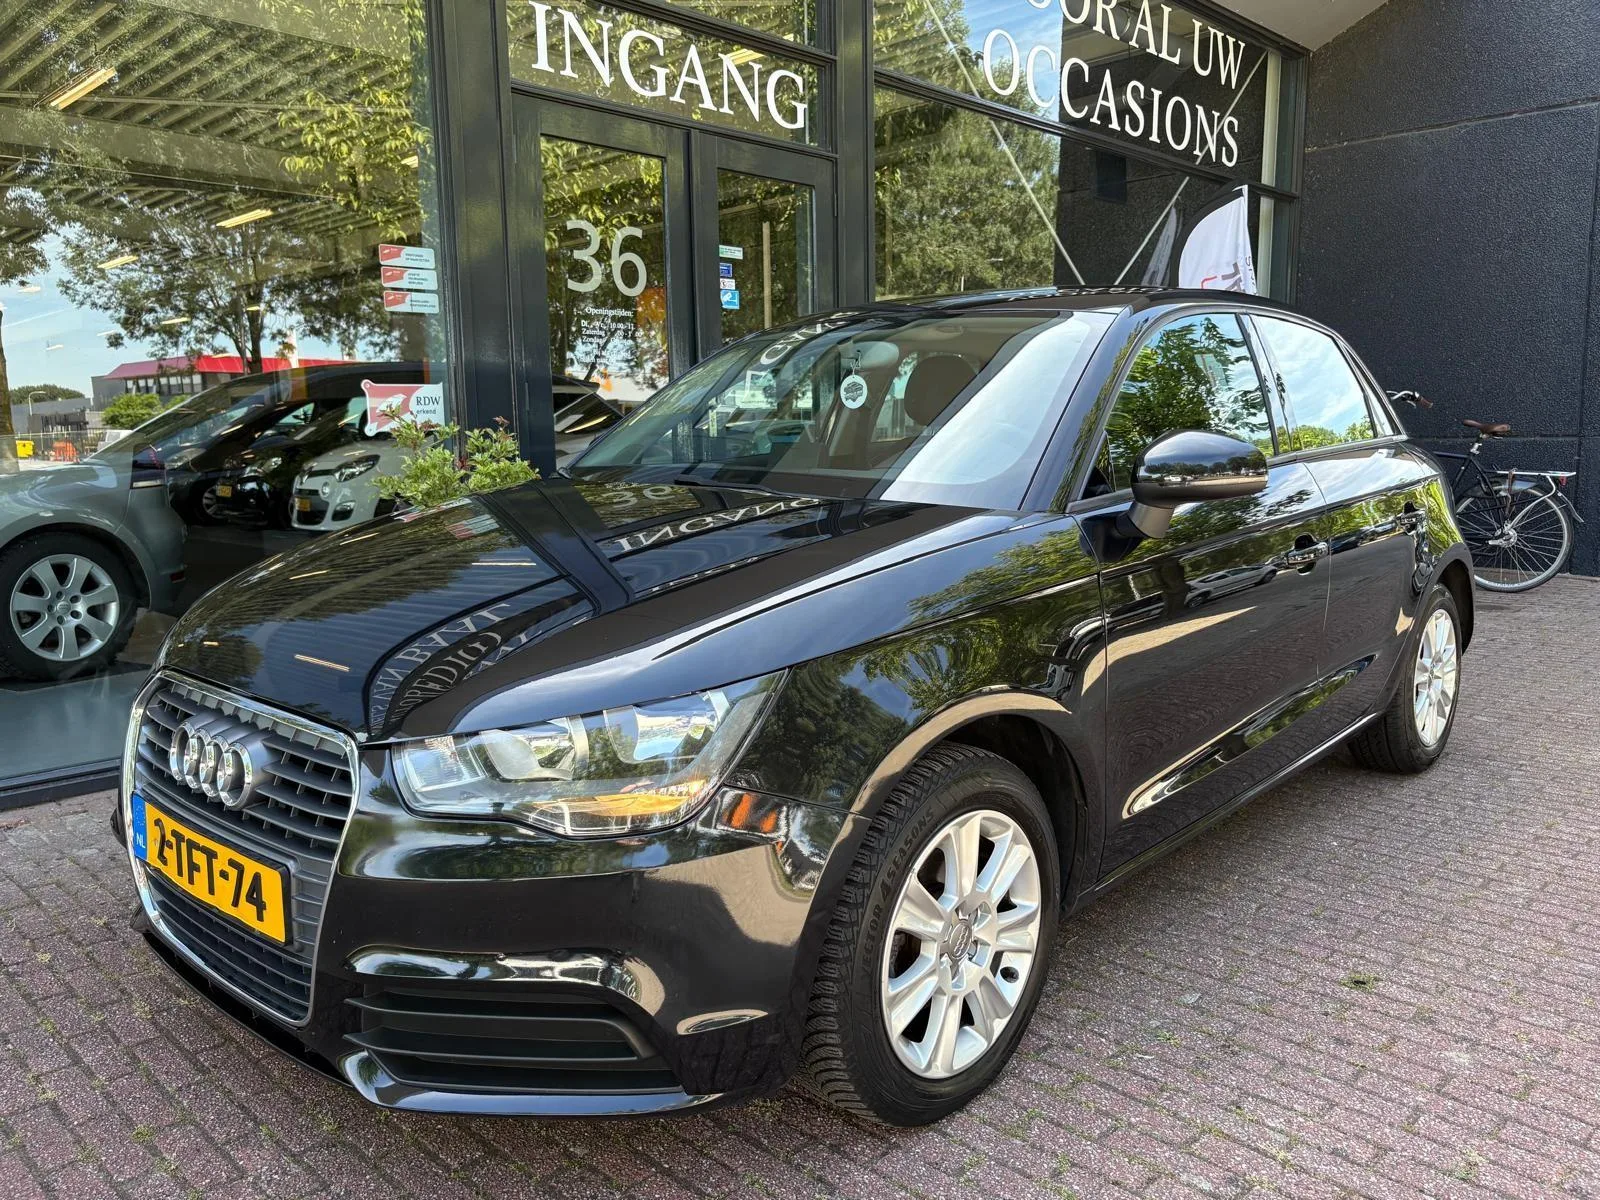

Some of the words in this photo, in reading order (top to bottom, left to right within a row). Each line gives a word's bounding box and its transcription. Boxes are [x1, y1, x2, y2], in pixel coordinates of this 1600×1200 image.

[529, 0, 808, 129] INGANG
[1129, 0, 1181, 65] AL
[1192, 18, 1246, 90] UW
[982, 28, 1239, 167] OCCASIONS
[566, 219, 648, 297] 36
[416, 396, 441, 406] RDW
[136, 832, 146, 849] NL
[154, 817, 267, 922] 2-TFT-74
